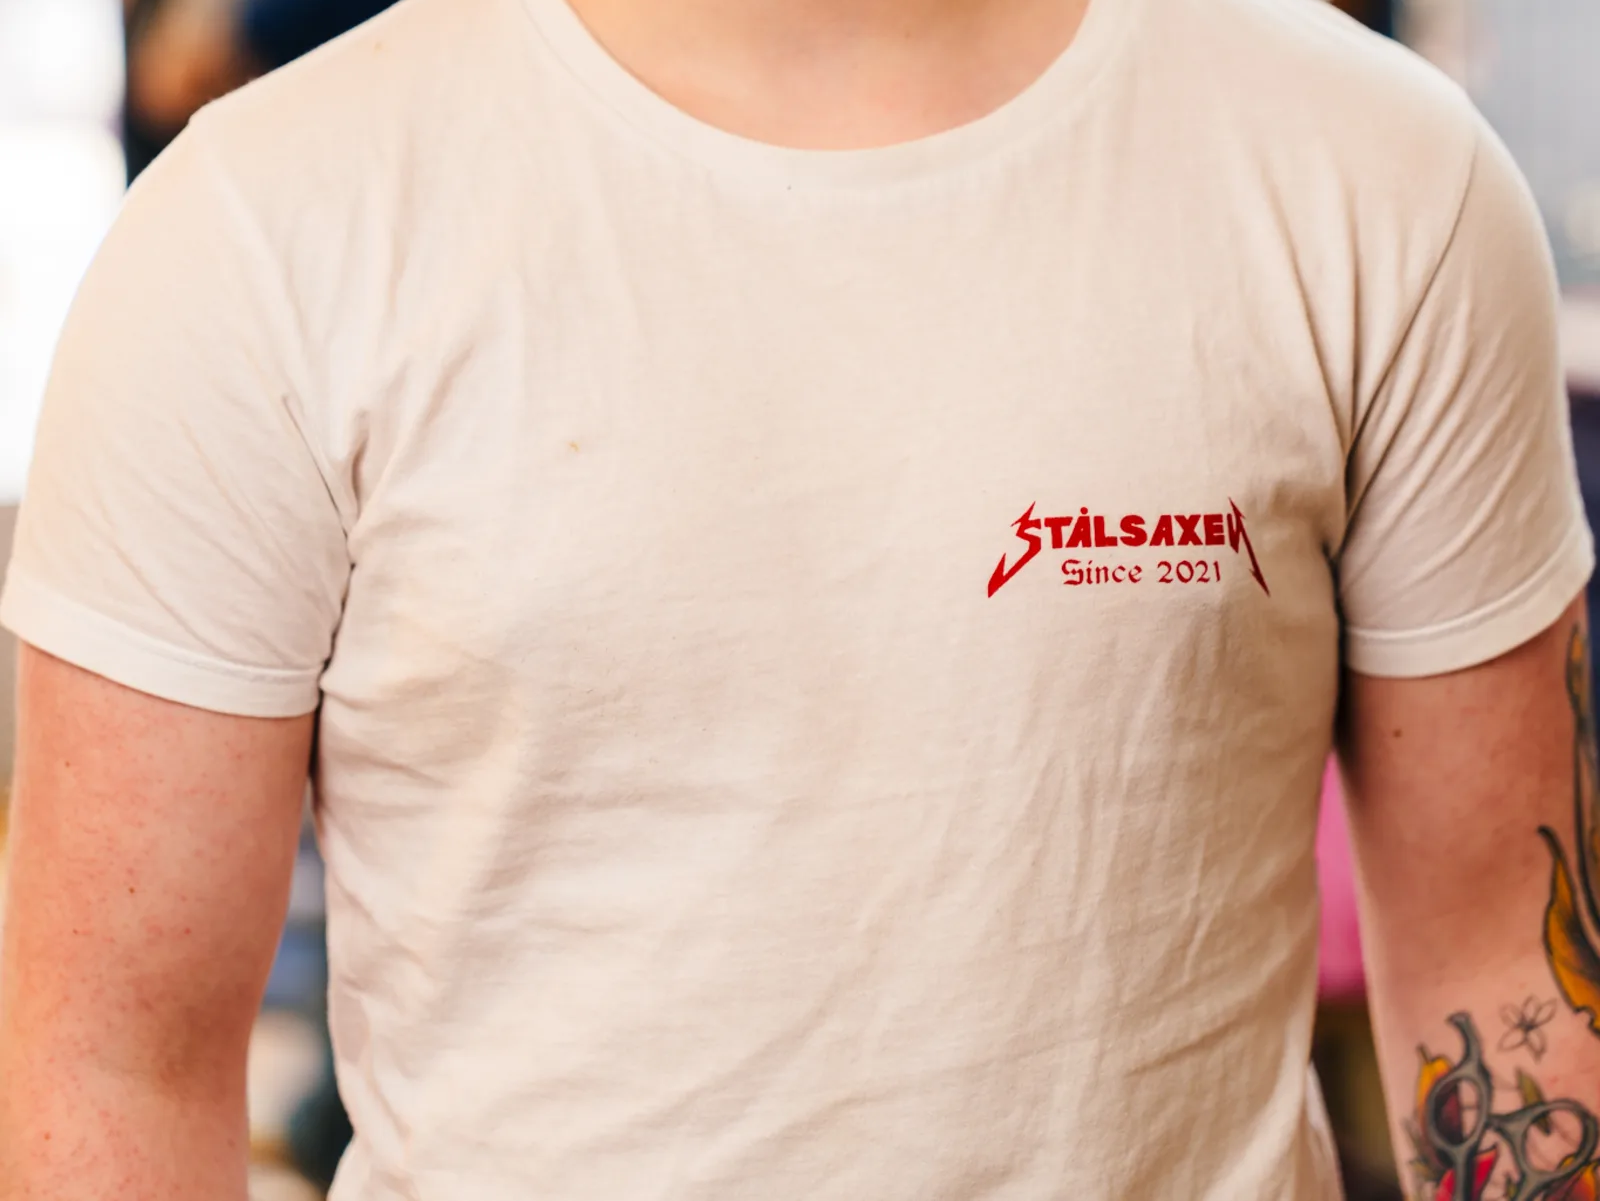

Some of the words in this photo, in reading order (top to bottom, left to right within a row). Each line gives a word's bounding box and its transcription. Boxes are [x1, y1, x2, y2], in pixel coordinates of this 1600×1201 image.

[988, 497, 1270, 597] STÅLSAXEN
[1061, 559, 1142, 585] Since
[1157, 560, 1221, 583] 2021
